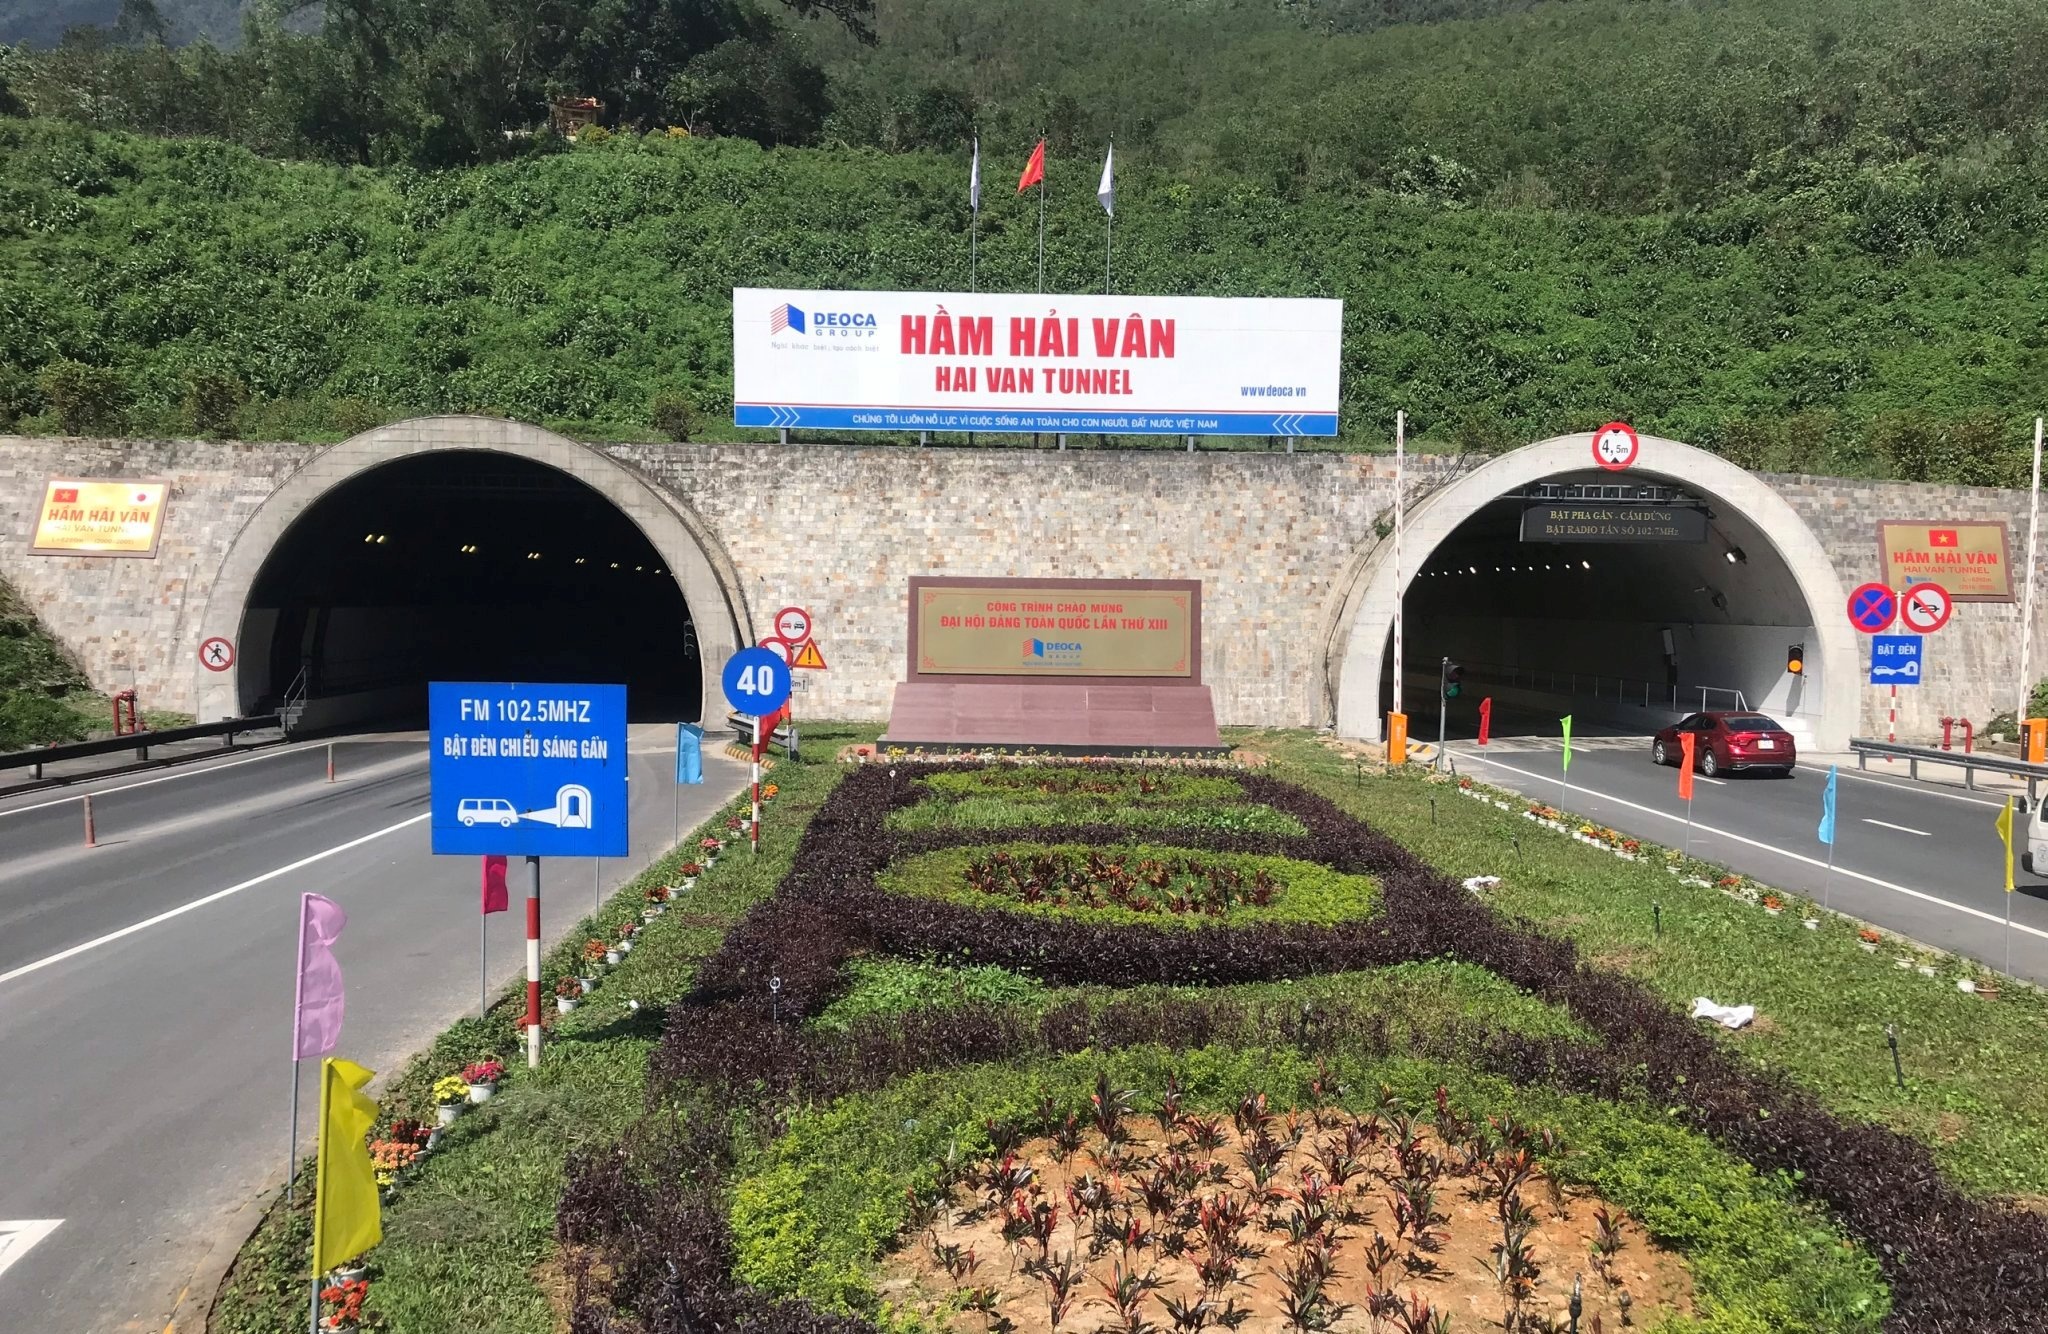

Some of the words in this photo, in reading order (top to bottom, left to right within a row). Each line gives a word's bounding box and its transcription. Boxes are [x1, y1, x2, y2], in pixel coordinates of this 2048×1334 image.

[814, 313, 877, 326] DEOCA
[816, 329, 875, 337] GROUP
[900, 304, 993, 356] HẦM
[1010, 308, 1079, 357] HẢI
[1092, 312, 1175, 358] VÂN
[935, 366, 976, 392] HAI
[986, 367, 1033, 393] VAN
[1042, 368, 1133, 395] TUNNEL
[852, 413, 882, 424] CHÚNG
[885, 413, 898, 424] TÔI
[900, 414, 924, 424] LUÔN
[960, 413, 969, 425] VÌ
[995, 414, 1018, 426] SỐNG
[1020, 417, 1034, 426] AN
[1036, 415, 1060, 427] TOÀN
[1062, 417, 1080, 427] CHO
[1081, 418, 1099, 427] CON
[1131, 416, 1148, 429] ĐẤT
[1150, 417, 1174, 429] NƯỚC
[1176, 417, 1195, 430] VIỆT
[1197, 419, 1218, 429] NAM
[89, 506, 115, 522] HẢI
[120, 508, 150, 523] VÂN
[1550, 510, 1569, 522] BẬT
[1571, 511, 1592, 520] PHA
[1546, 524, 1564, 536] BẬT
[1566, 525, 1598, 534] RADIO
[1637, 526, 1680, 536] 102.7MHz
[1893, 548, 1930, 564] HẦM
[1935, 549, 1963, 564] HẢI
[1966, 550, 1998, 565] VÂN
[1949, 566, 1990, 574] TUNNEL
[941, 615, 960, 630] ĐẠI
[965, 614, 985, 630] HỘI
[1058, 614, 1090, 630] QUỐC
[1121, 616, 1145, 630] THỨ
[1148, 618, 1168, 630] XIII
[1046, 642, 1082, 651] DEOCA
[1877, 643, 1895, 656] BẬT
[1898, 643, 1916, 655] ĐÈN
[736, 665, 774, 696] 40
[460, 699, 489, 721] FM
[496, 700, 591, 723] 102.5MHZ
[443, 733, 467, 760] BẬT
[471, 734, 497, 757] ĐÈN
[500, 734, 539, 758] CHIẾU
[543, 735, 577, 759] SÁNG
[581, 736, 607, 760] GẦN
